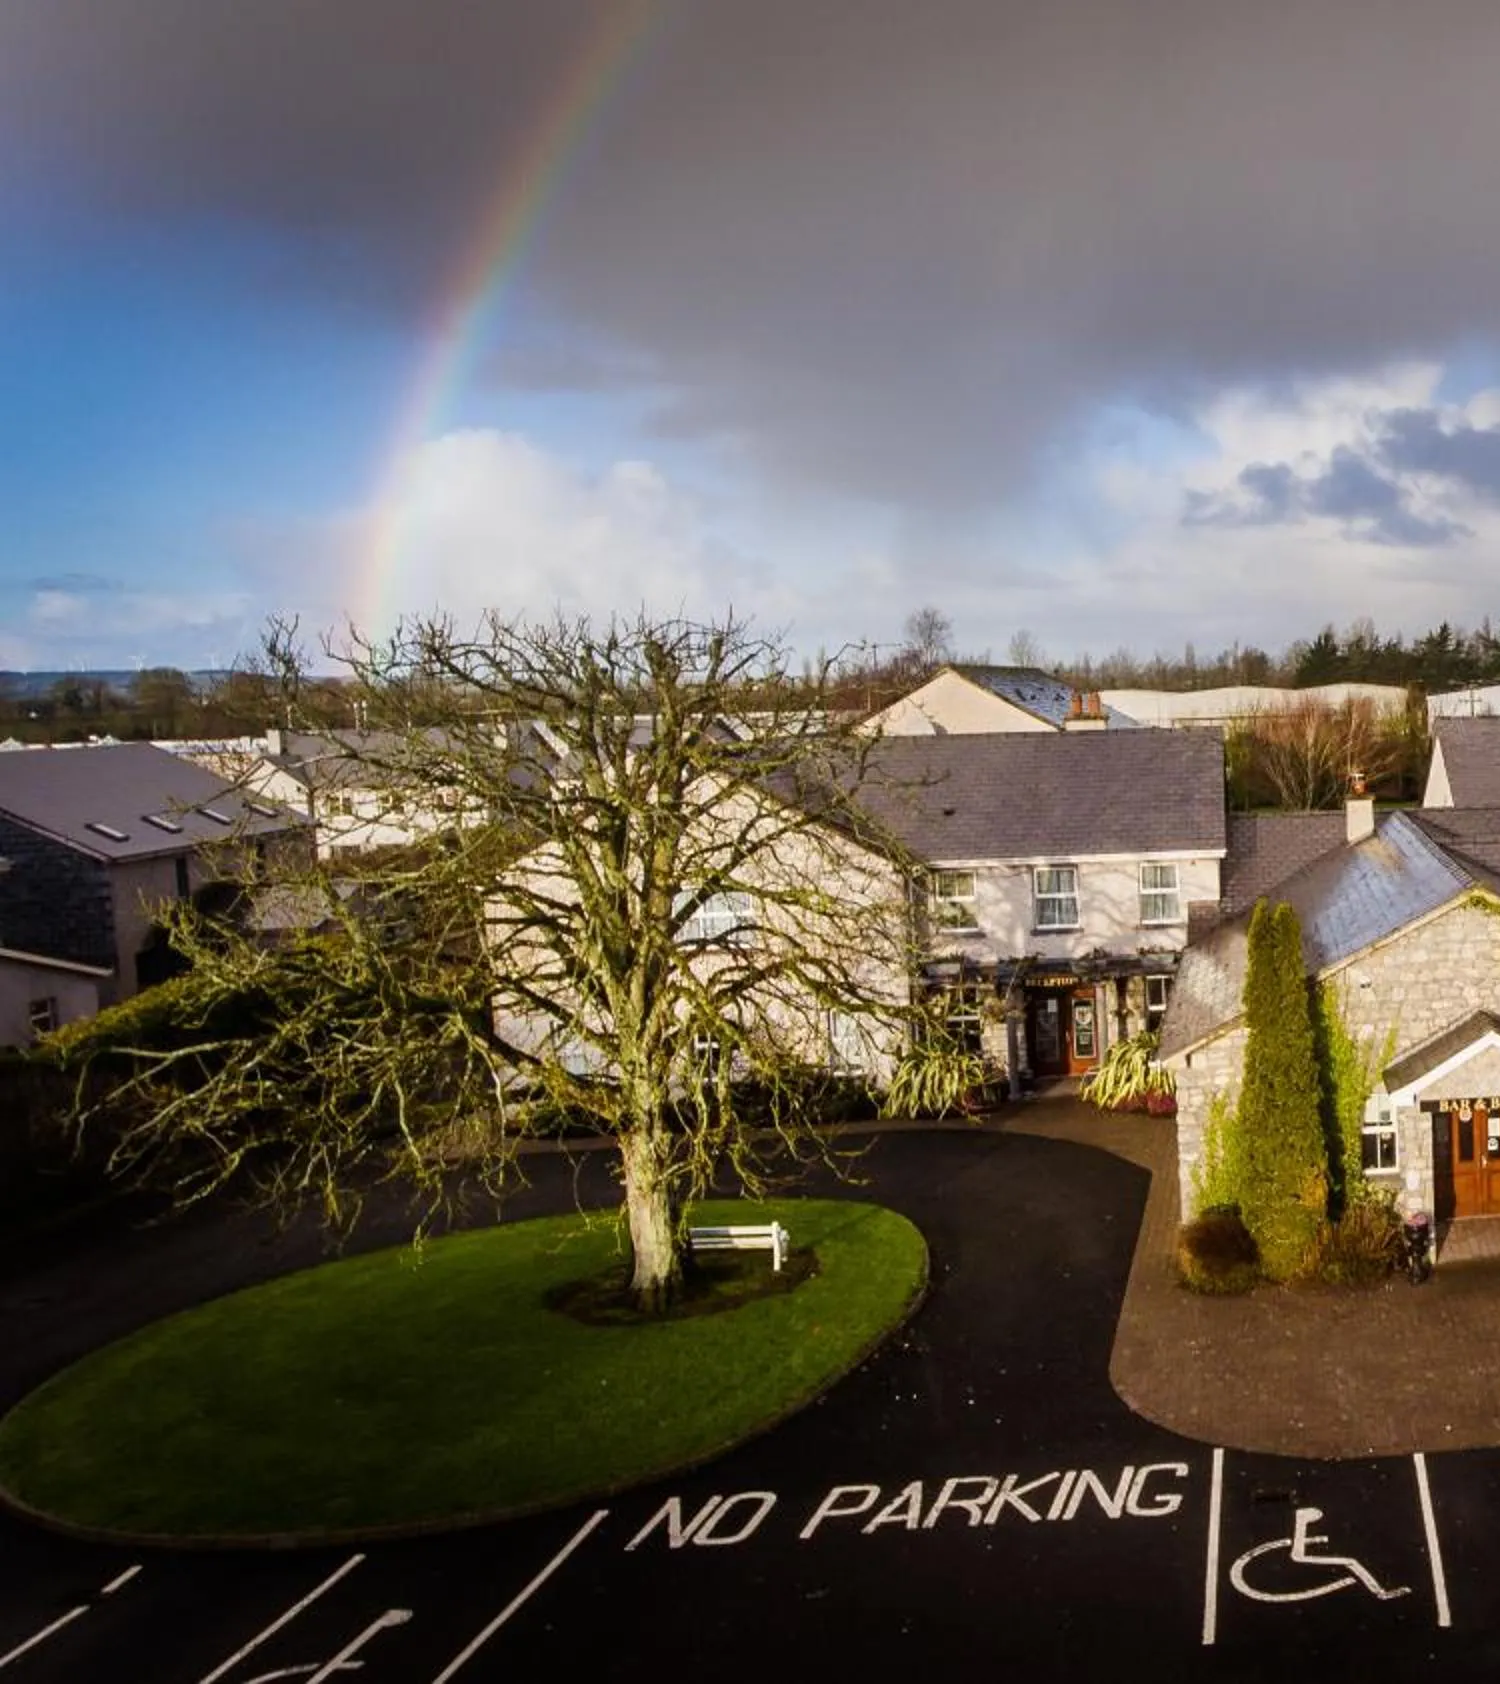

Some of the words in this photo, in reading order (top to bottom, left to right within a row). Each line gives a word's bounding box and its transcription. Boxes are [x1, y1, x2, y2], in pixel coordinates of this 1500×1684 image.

[1439, 1099, 1471, 1112] BAR
[1474, 1098, 1487, 1110] &
[624, 1492, 777, 1551] NO
[800, 1463, 1189, 1539] PARKING
